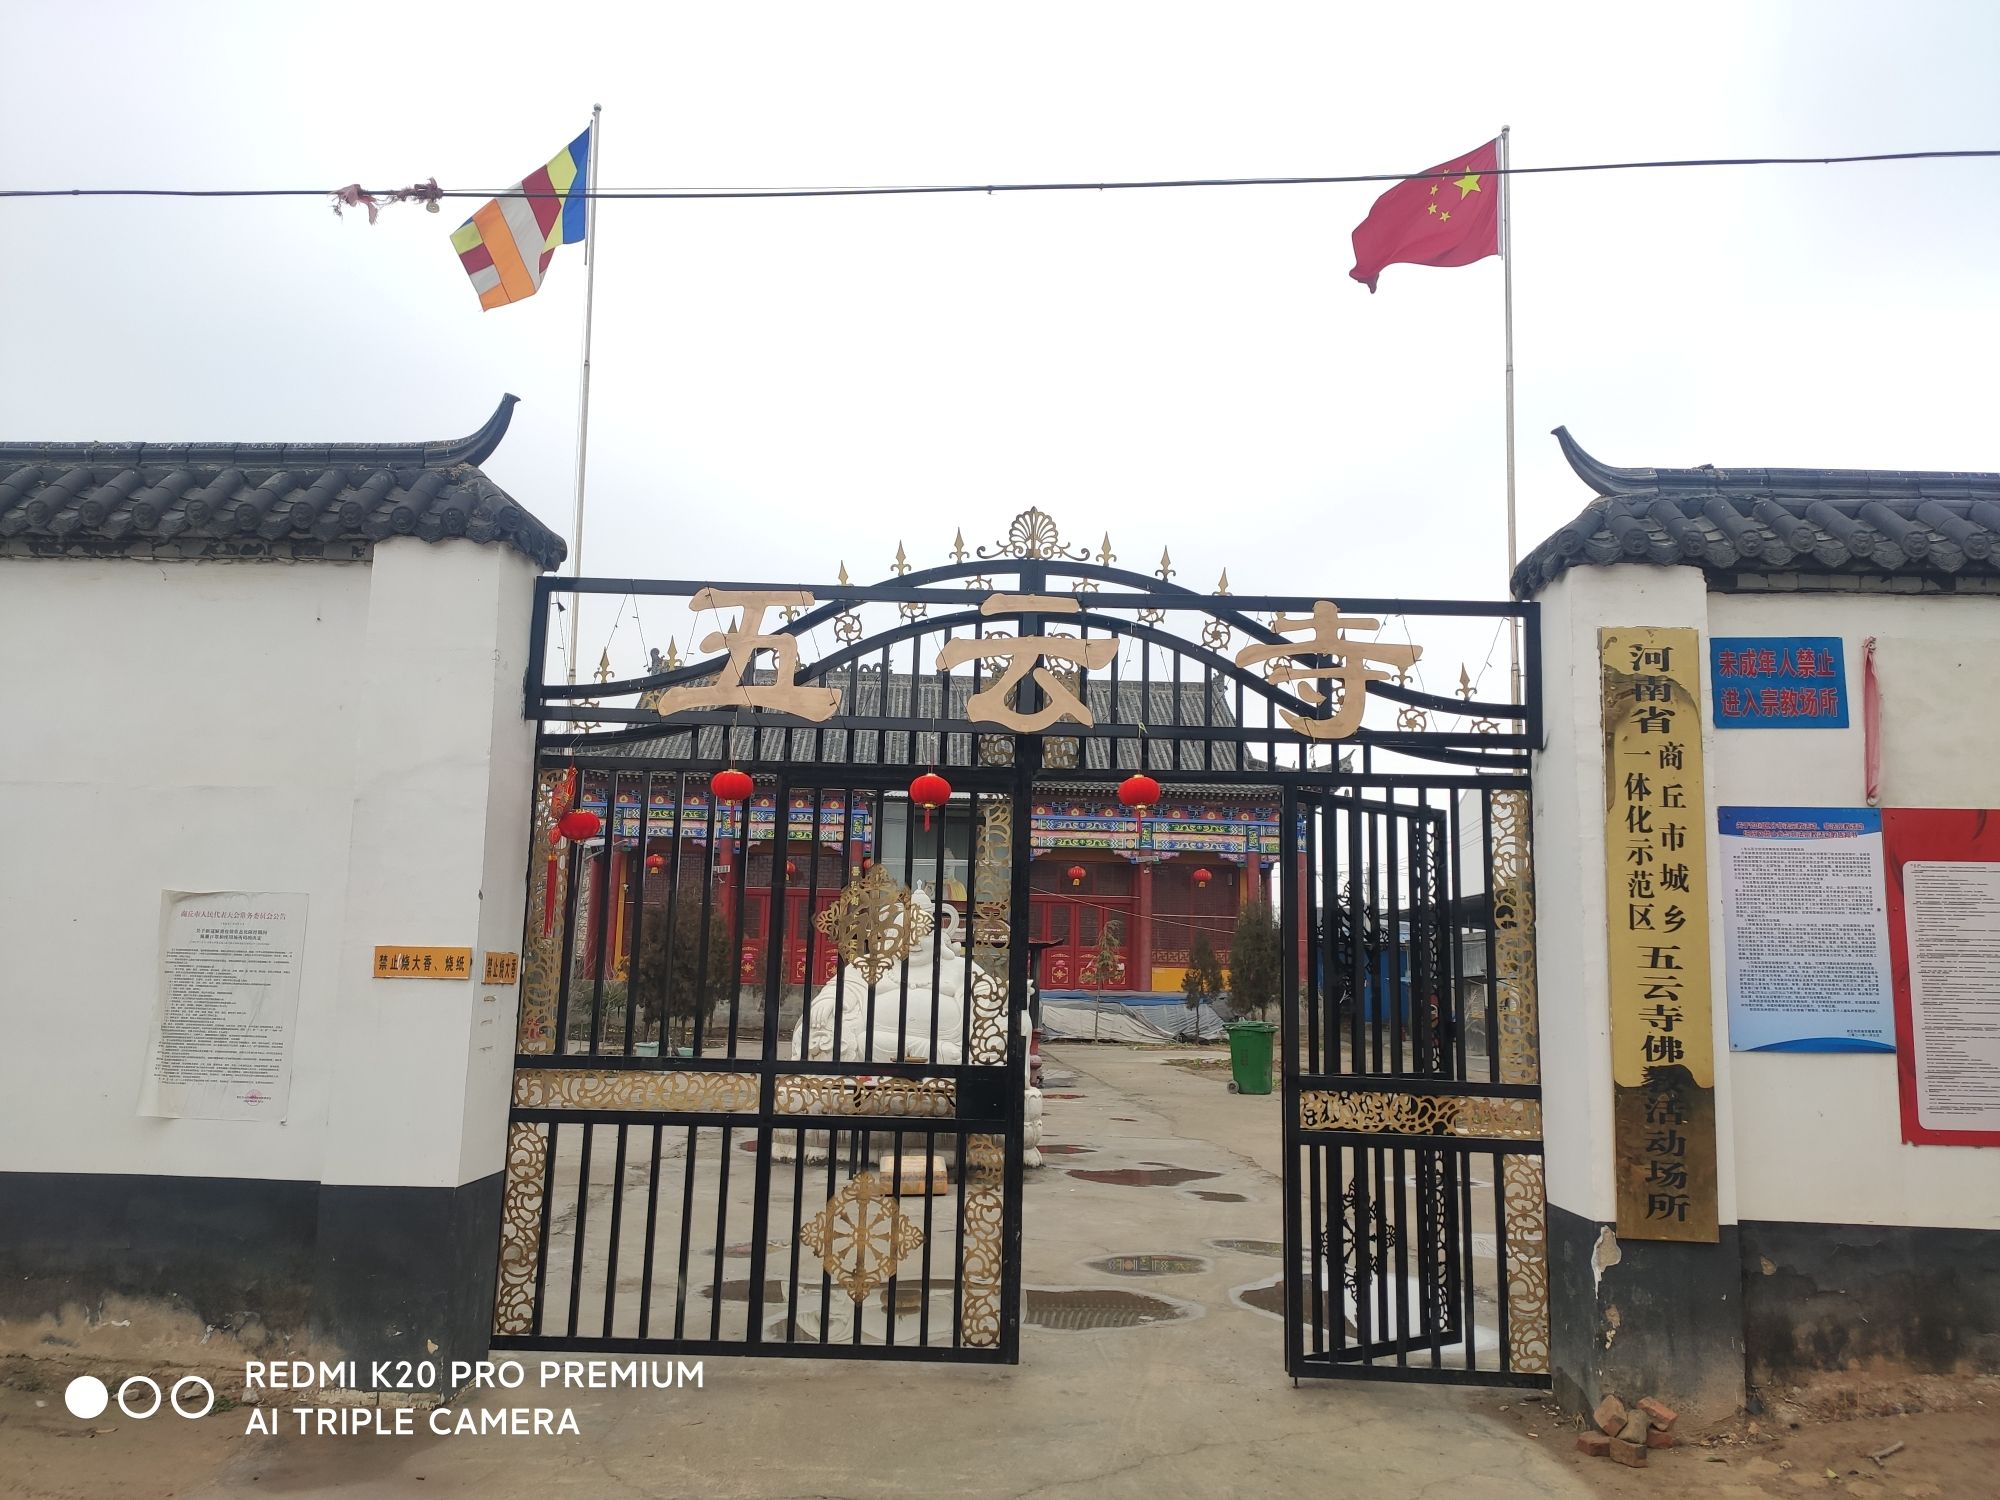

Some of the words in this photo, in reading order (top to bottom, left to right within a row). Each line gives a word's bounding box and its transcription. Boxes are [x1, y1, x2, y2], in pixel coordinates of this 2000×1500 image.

[658, 587, 1423, 740] 五云寺
[1628, 643, 1675, 734] 河南省
[1719, 648, 1836, 678] 未成年人禁止
[1721, 687, 1839, 717] 进入宗教场所
[1623, 750, 1656, 931] 一体化示范区
[1658, 741, 1690, 934] 商丘市城乡
[378, 953, 466, 973] 禁止烧大香、烧纸
[486, 957, 519, 979] 禁止烧大香
